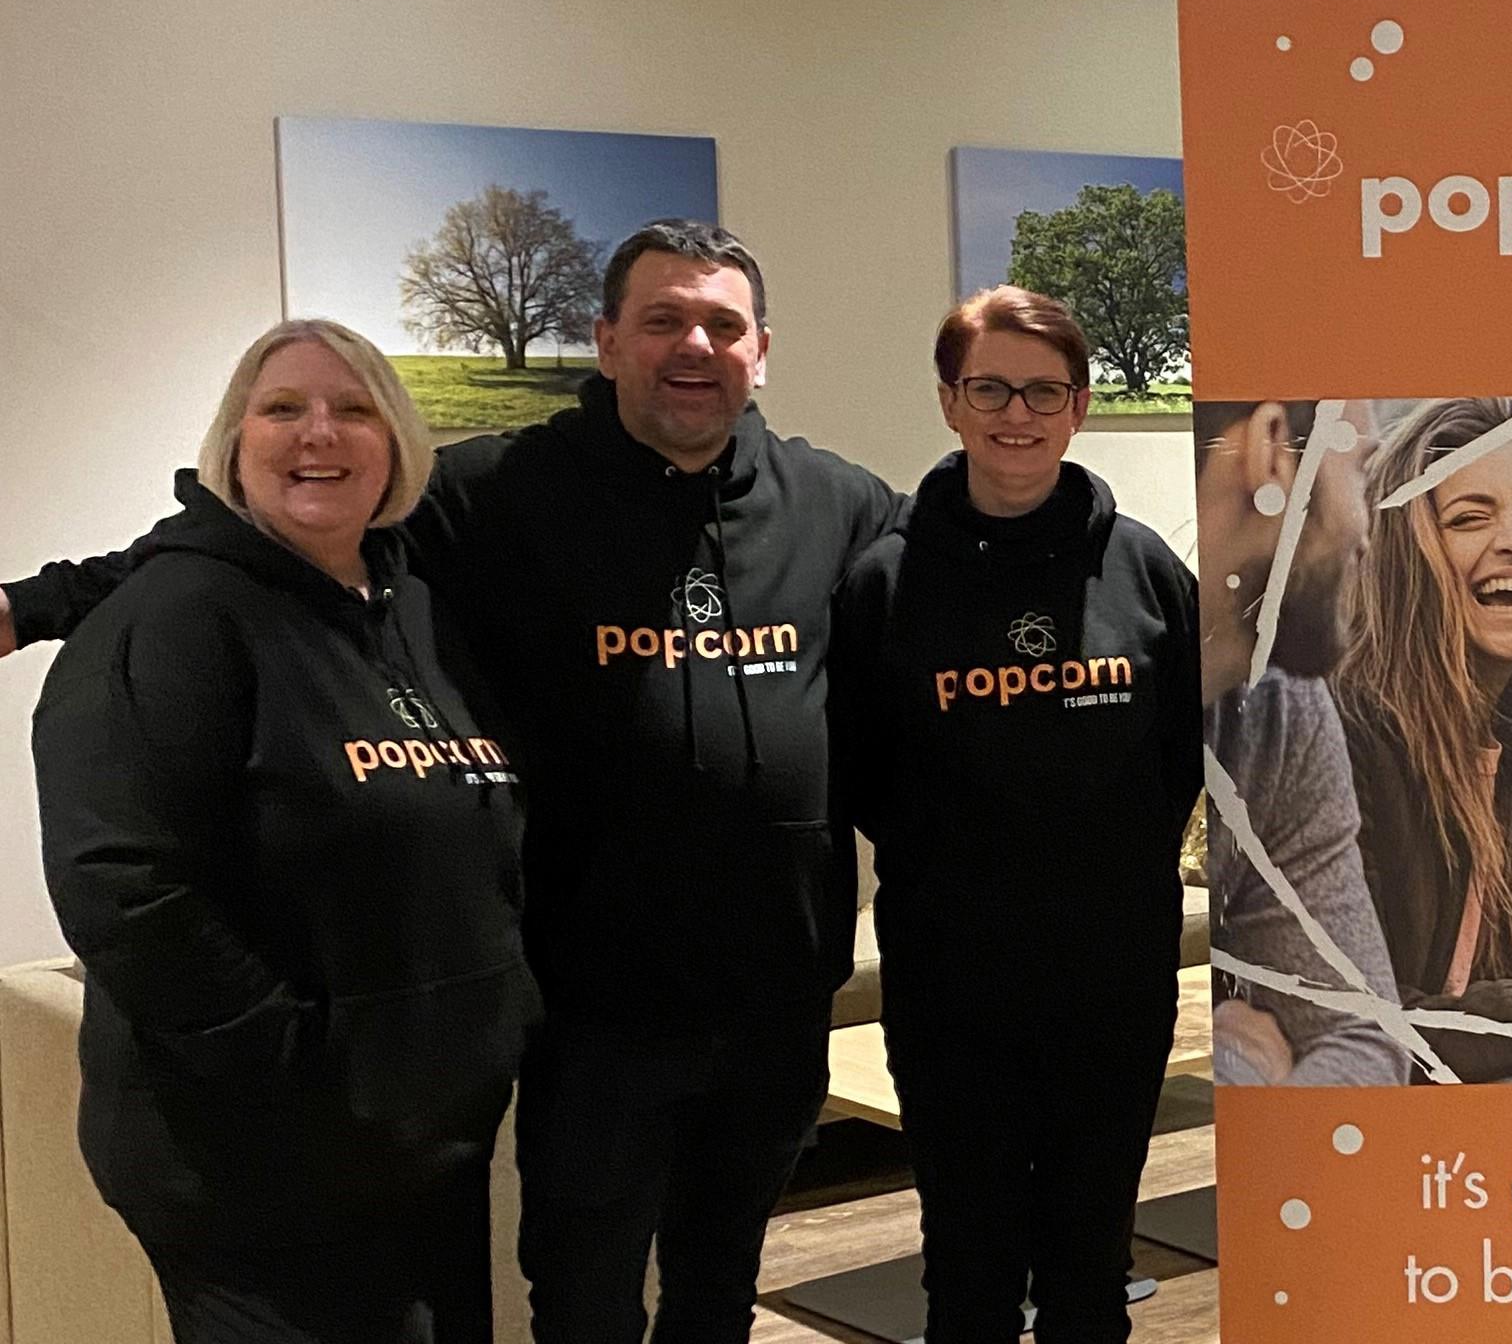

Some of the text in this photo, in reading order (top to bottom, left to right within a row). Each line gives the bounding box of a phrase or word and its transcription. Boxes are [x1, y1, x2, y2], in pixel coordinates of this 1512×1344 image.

[597, 623, 797, 668] popcorn
[936, 656, 1131, 711] popcorn
[1420, 1151, 1489, 1209] it's
[1404, 1255, 1459, 1304] to
